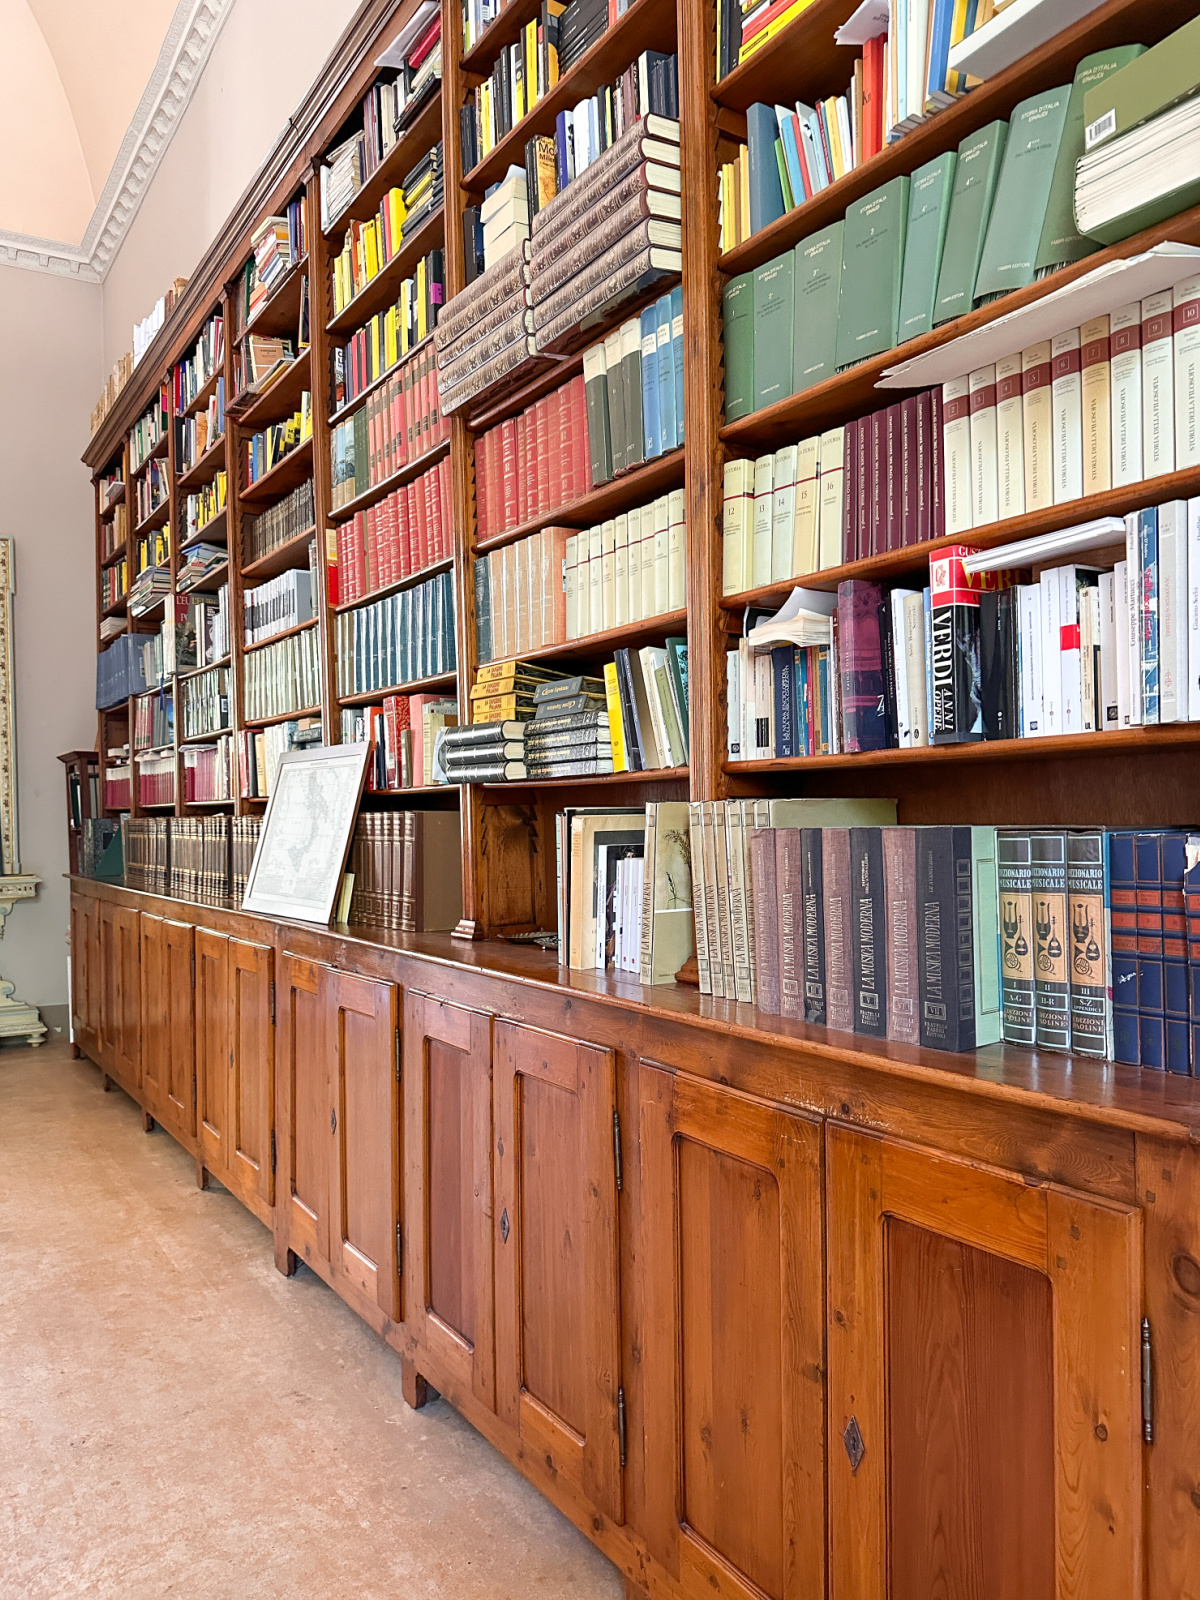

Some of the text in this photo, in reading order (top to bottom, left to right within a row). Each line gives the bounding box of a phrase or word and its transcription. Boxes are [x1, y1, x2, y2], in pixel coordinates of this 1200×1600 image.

[1020, 101, 1060, 120] STORIA D'ITALIA
[1187, 308, 1195, 318] 10
[827, 436, 840, 444] STORIA
[802, 490, 808, 499] 15
[826, 482, 834, 490] 16
[728, 508, 734, 516] 12
[760, 504, 764, 512] 13
[778, 498, 784, 506] 14
[933, 608, 953, 688] VERDI
[934, 690, 942, 730] OPERE
[944, 688, 954, 730] ANNI
[642, 882, 650, 950] LA MUSICA MODERNA
[694, 884, 706, 956] LA MUSICA MODERNA
[706, 884, 718, 958] LA MUSICA MODERNA
[718, 886, 730, 960] LA MUSICA MODERNA
[732, 888, 746, 964] LA MUSICA MODERNA
[782, 893, 794, 934] MODERNA
[892, 900, 908, 947] MODERNA
[783, 936, 794, 964] MUSICA
[806, 894, 819, 980] LA MUSICA MODERNA
[830, 896, 844, 986] LA MUSICA MODERNA
[860, 898, 874, 990] LA MUSICA MODERNA
[924, 901, 942, 1000] LA MUSICA MODERNA
[784, 965, 794, 976] LA
[894, 948, 908, 980] MUSICA
[894, 982, 909, 994] LA
[1009, 994, 1022, 1002] A-G
[930, 1006, 940, 1014] VII
[1072, 1016, 1104, 1025] EDIZIONI
[1072, 1023, 1104, 1032] PAOLINE
